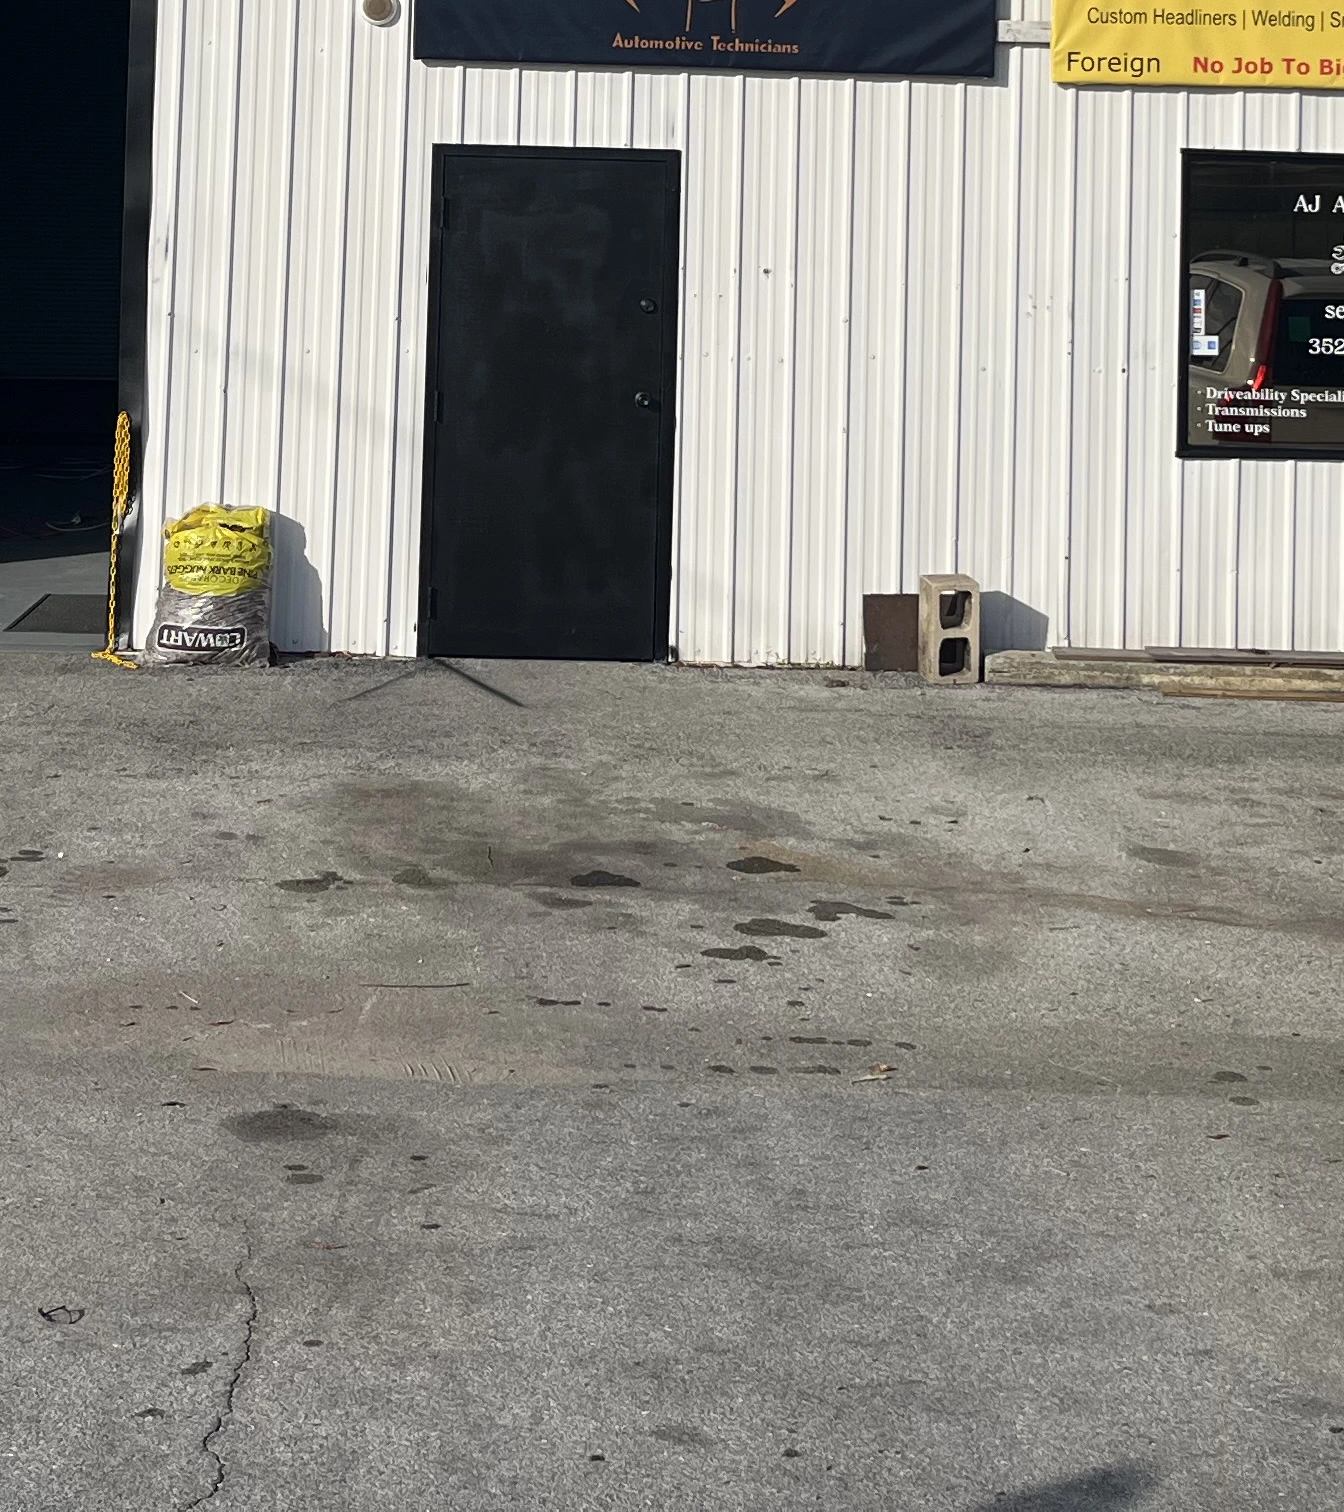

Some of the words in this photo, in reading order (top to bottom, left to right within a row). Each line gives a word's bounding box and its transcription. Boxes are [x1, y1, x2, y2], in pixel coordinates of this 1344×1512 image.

[1088, 8, 1147, 24] Custom
[1154, 9, 1236, 26] Headliners
[1252, 10, 1314, 31] Welding
[612, 34, 704, 49] Automotive
[711, 36, 800, 54] Technicians
[1068, 52, 1160, 77] Foreign
[1194, 57, 1223, 73] No
[1232, 58, 1273, 74] Job
[1282, 59, 1309, 75] To
[1294, 195, 1320, 212] AJ
[1205, 387, 1287, 404] Driveability
[1205, 403, 1307, 417] Transmissions
[1205, 420, 1240, 432] Tune
[1245, 424, 1270, 435] ups
[167, 565, 207, 575] NUGGETS
[210, 566, 237, 575] BARK
